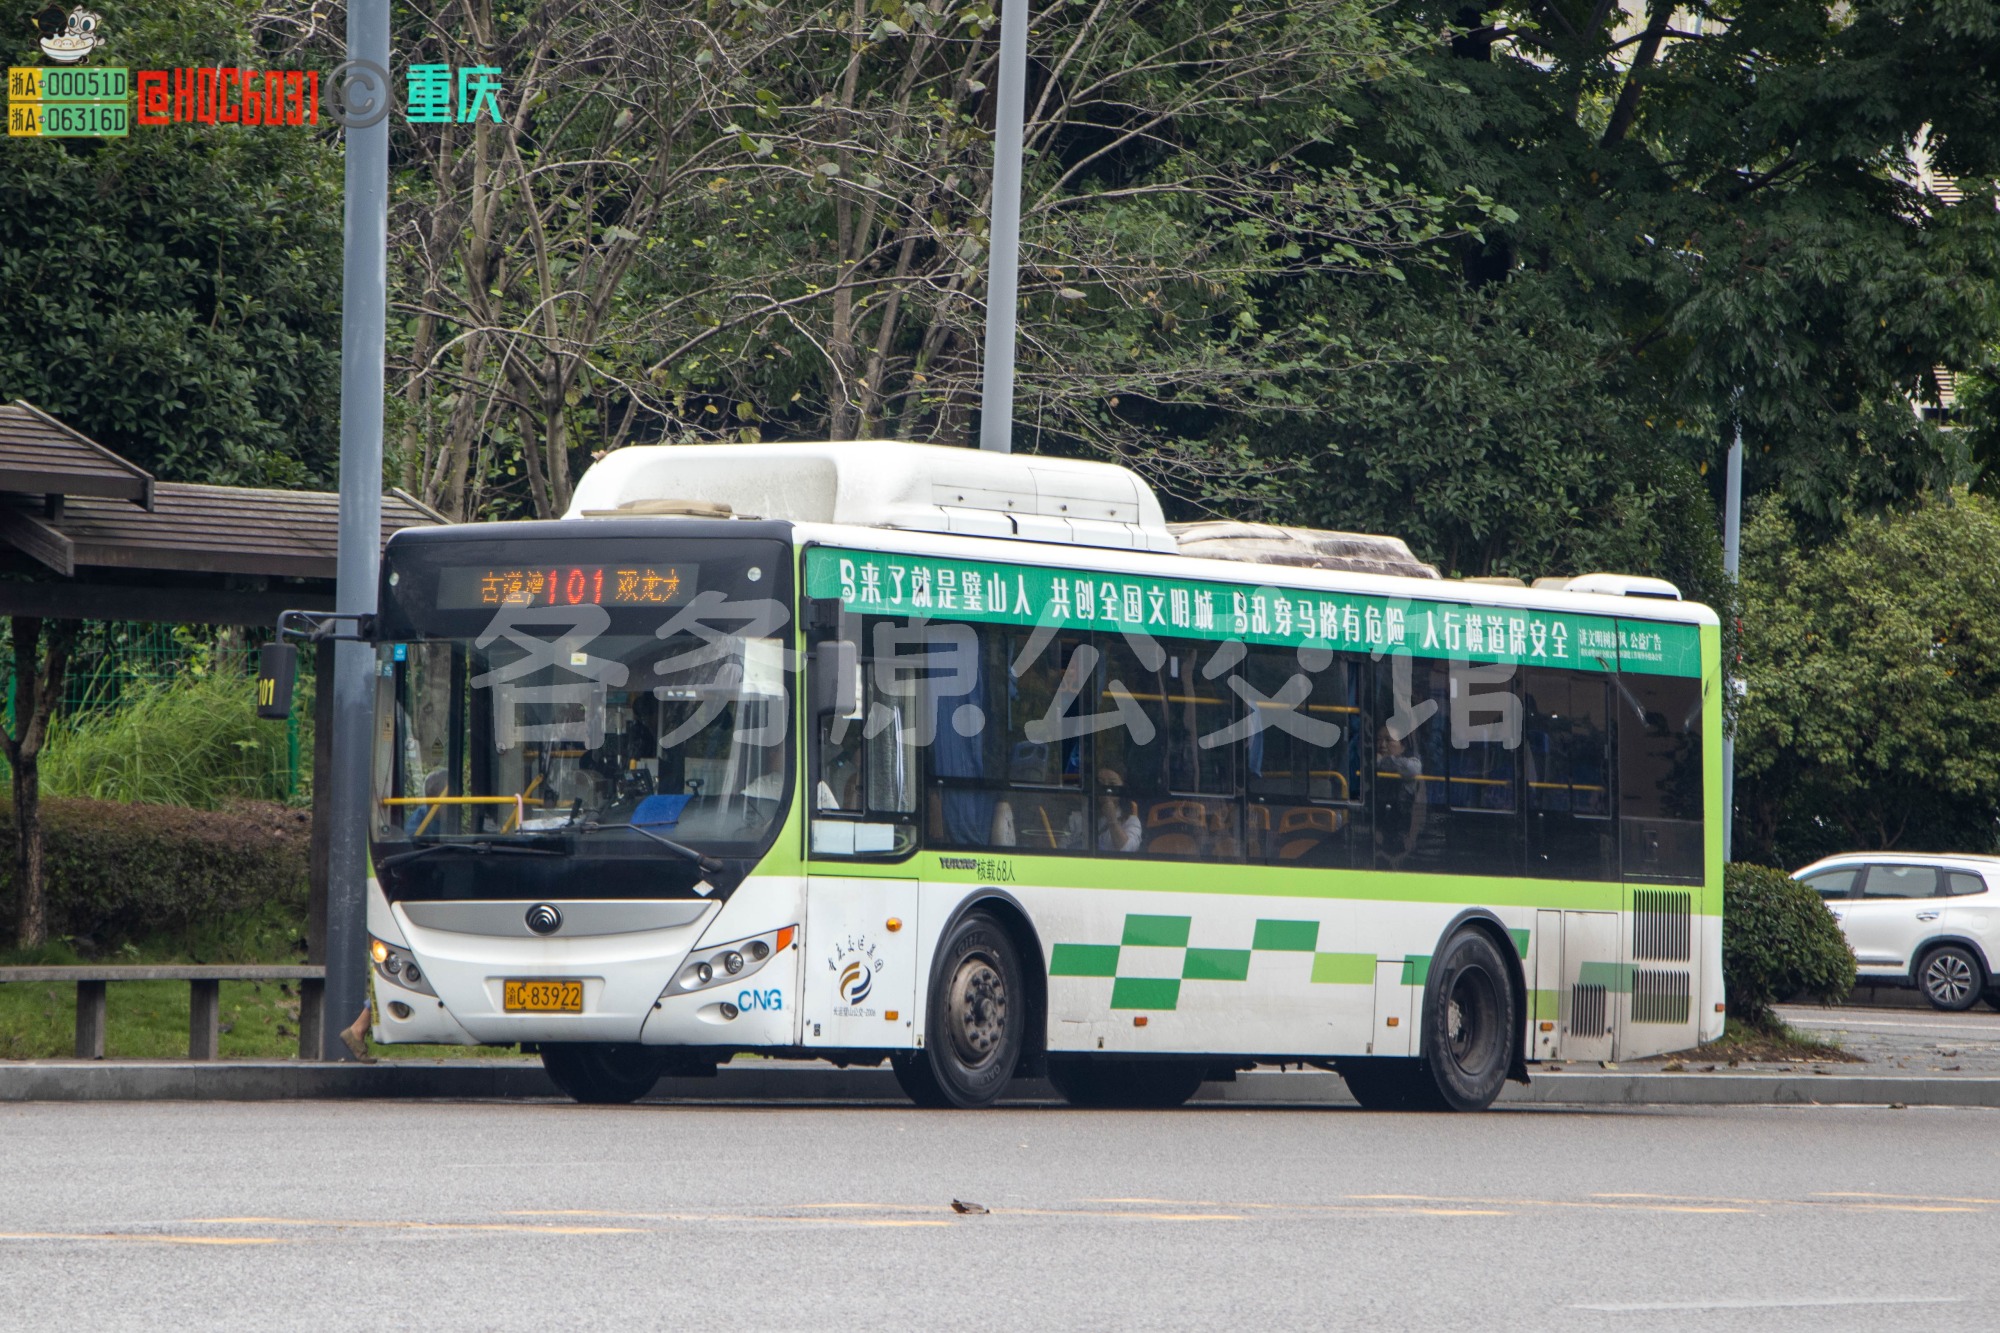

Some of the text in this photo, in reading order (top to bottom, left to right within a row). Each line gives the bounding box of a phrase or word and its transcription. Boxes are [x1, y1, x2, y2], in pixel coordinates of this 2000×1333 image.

[548, 569, 603, 604] 101
[1050, 577, 1214, 630] 共创全国文明城
[1251, 595, 1405, 646] 乱穿马路有危险
[1422, 610, 1569, 658] 人行横道保安全
[738, 988, 782, 1012] CNG
